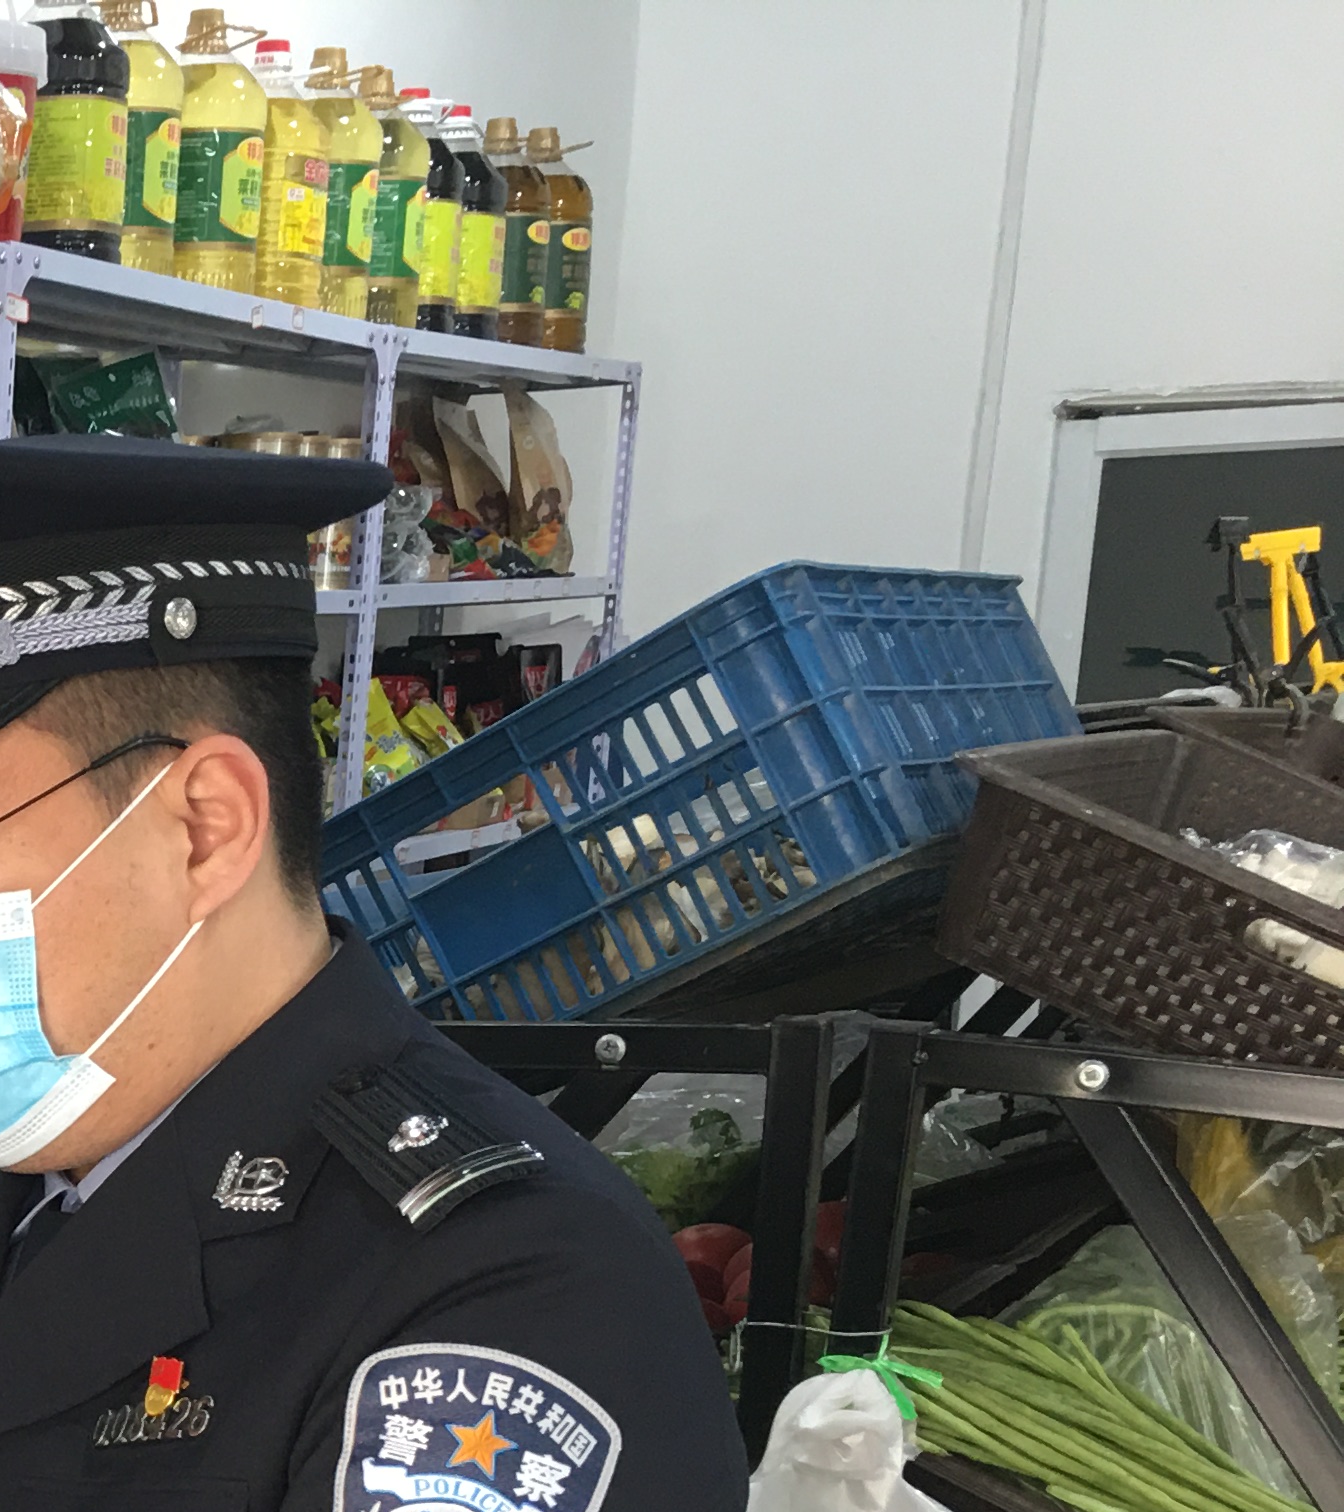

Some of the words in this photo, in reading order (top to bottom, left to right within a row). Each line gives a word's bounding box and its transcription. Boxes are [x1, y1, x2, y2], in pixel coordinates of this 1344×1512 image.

[376, 1413, 435, 1467] 警
[512, 1449, 572, 1509] 察
[378, 1366, 599, 1469] 中华人民共和国
